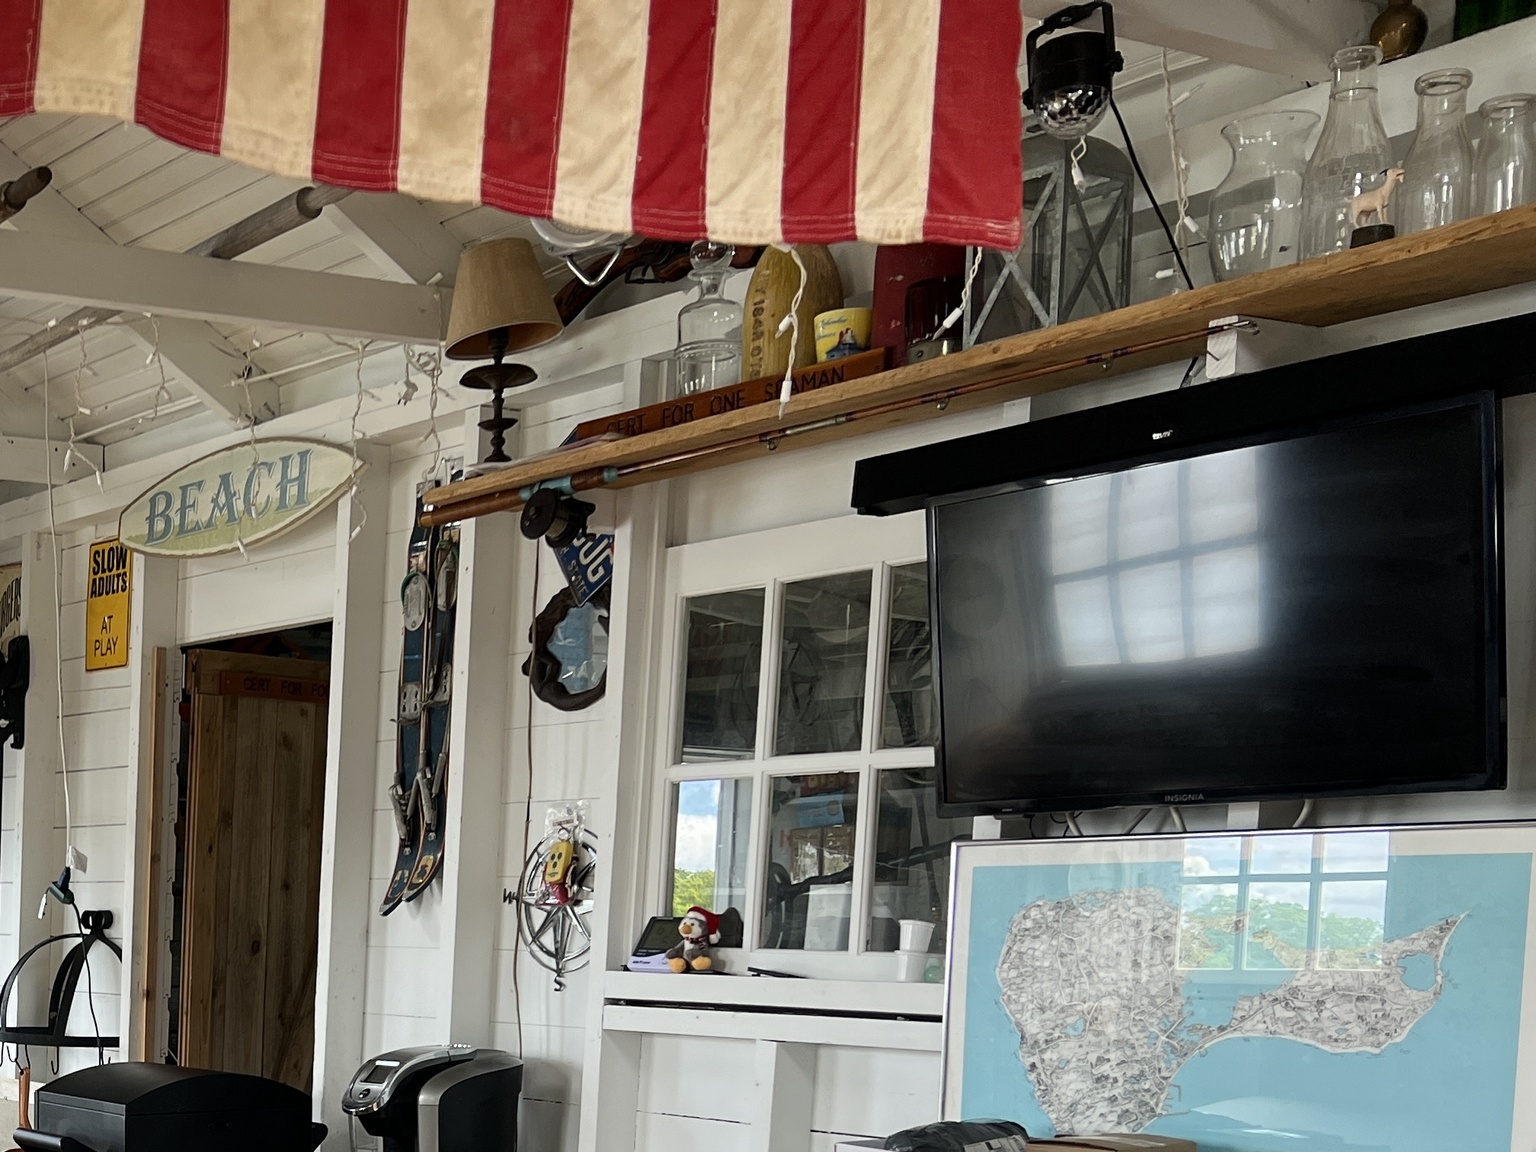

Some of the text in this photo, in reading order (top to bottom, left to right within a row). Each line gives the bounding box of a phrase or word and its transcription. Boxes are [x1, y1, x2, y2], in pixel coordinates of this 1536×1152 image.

[662, 402, 694, 427] FOR
[710, 389, 745, 416] ONE
[144, 448, 313, 547] BEACH
[92, 545, 128, 576] SLOW
[90, 571, 128, 599] ADULTS
[101, 615, 114, 635] AT
[94, 636, 119, 657] PLAY
[1164, 793, 1204, 802] INSIGNIA
